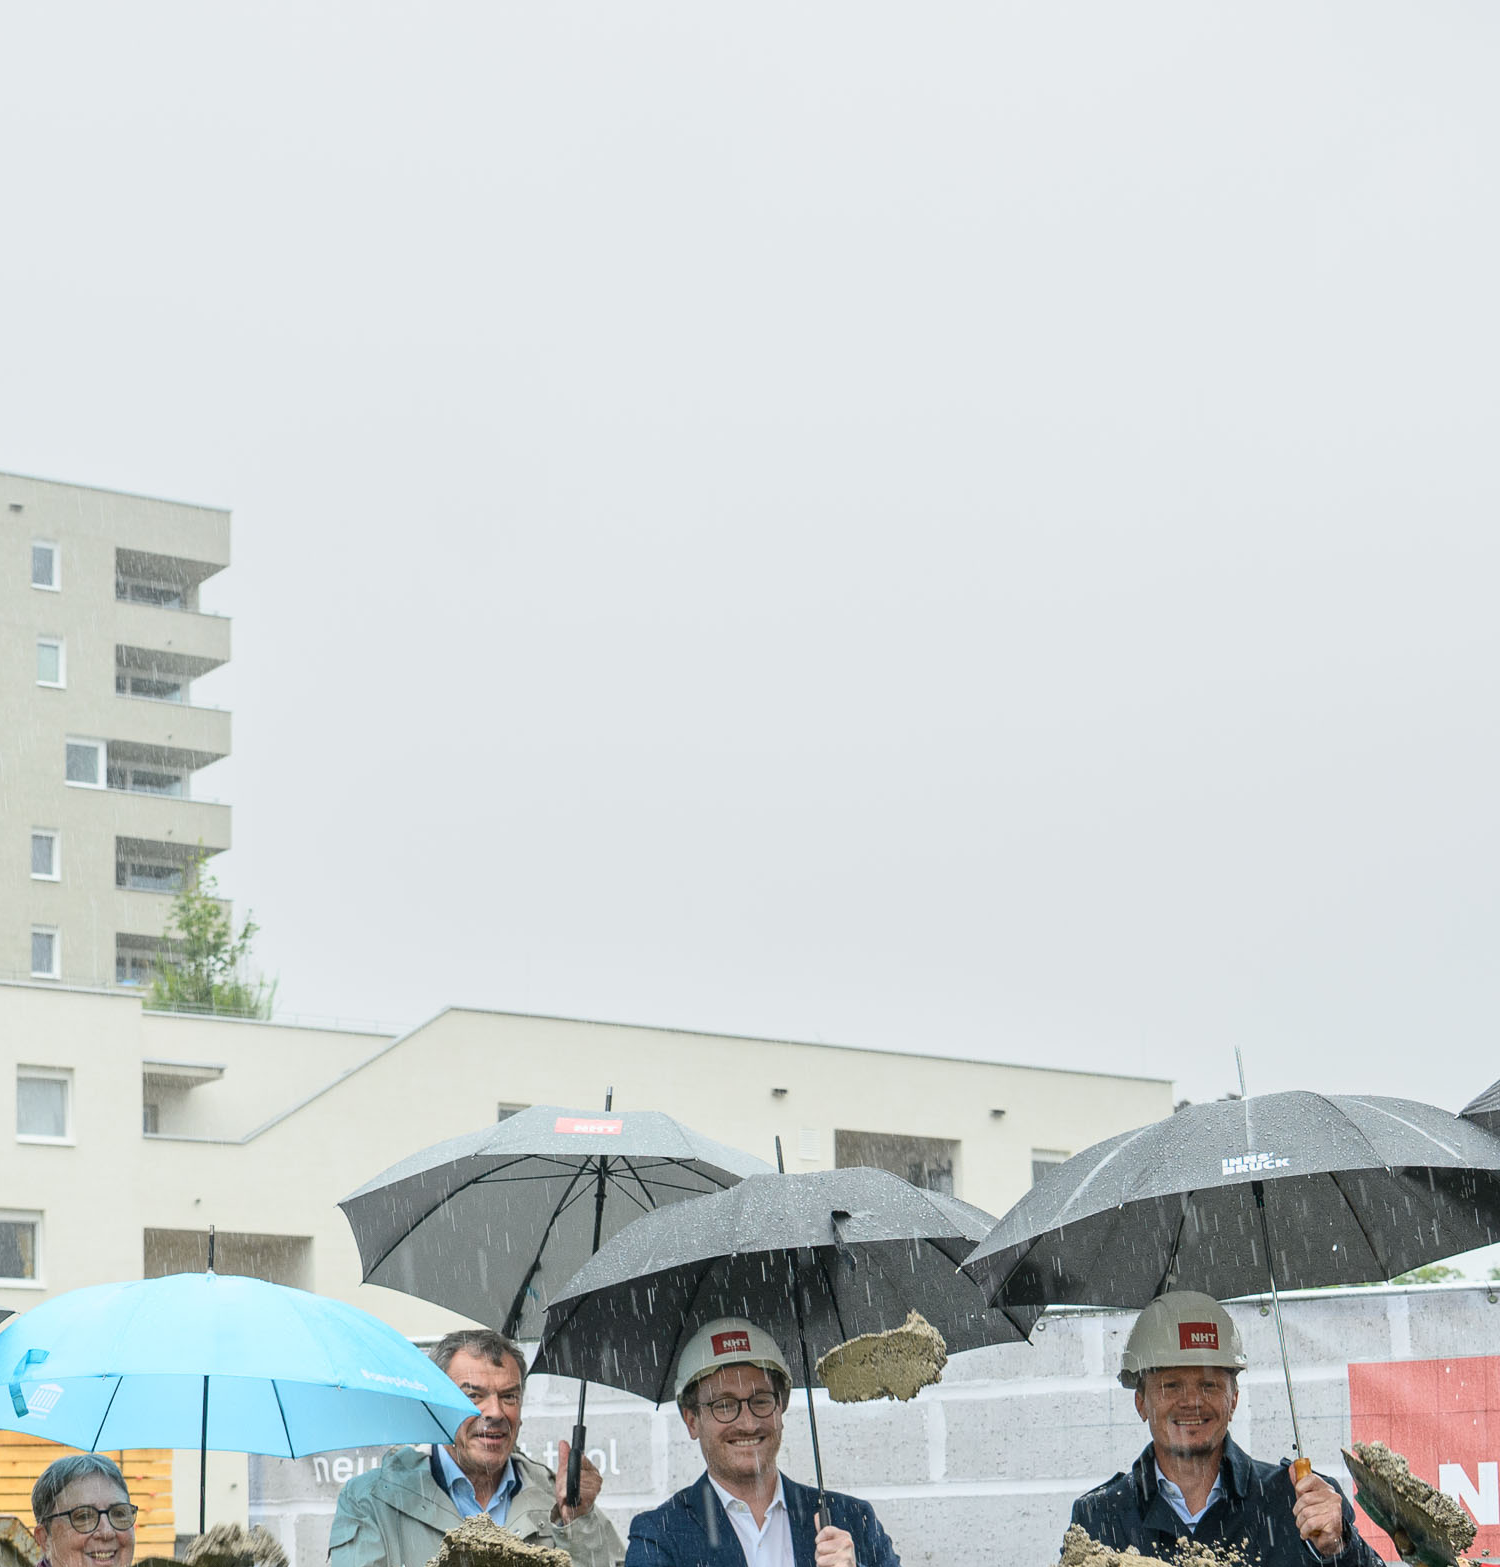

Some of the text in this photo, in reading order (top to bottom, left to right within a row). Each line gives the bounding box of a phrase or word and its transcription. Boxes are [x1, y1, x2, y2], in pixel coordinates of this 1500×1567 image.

[1222, 1158, 1291, 1177] BRUCK
[1190, 1332, 1216, 1343] NHT
[722, 1338, 748, 1349] NHT
